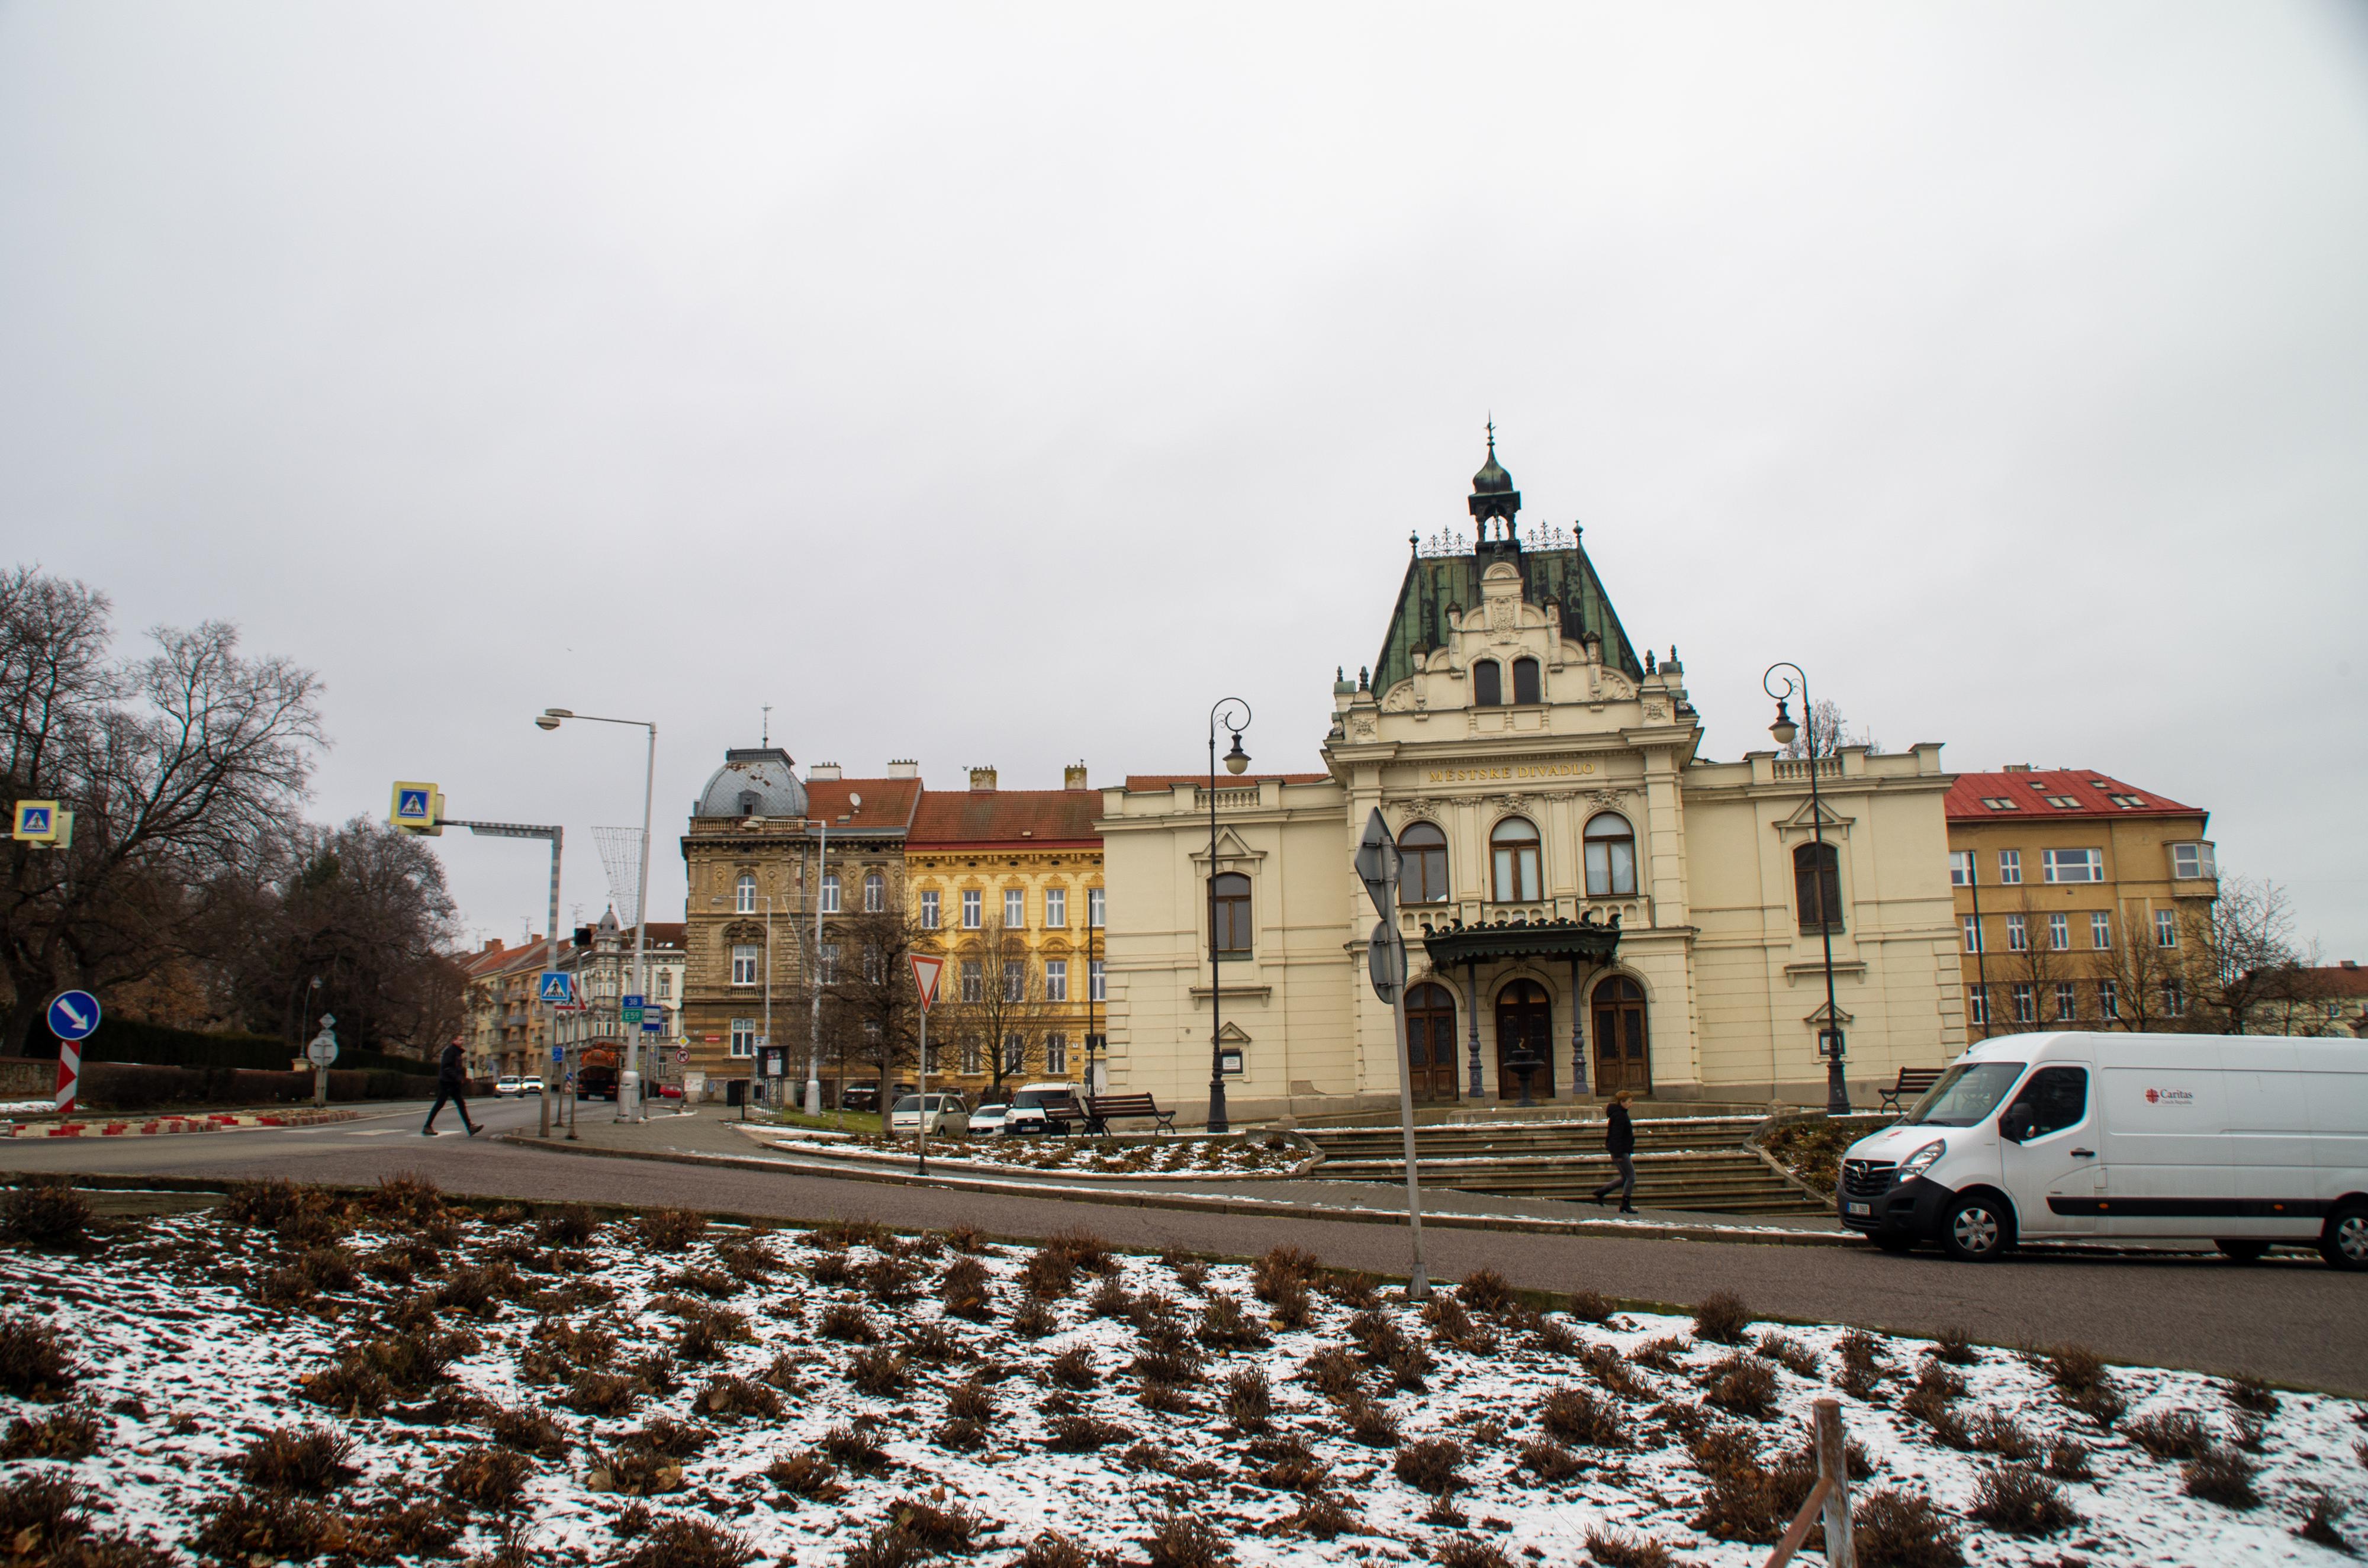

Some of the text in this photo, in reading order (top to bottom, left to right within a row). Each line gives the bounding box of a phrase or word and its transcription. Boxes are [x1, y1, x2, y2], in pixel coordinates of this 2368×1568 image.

[1429, 762, 1595, 783] MĚSTSKÉ DIVADLO
[2160, 1089, 2193, 1099] Caritas
